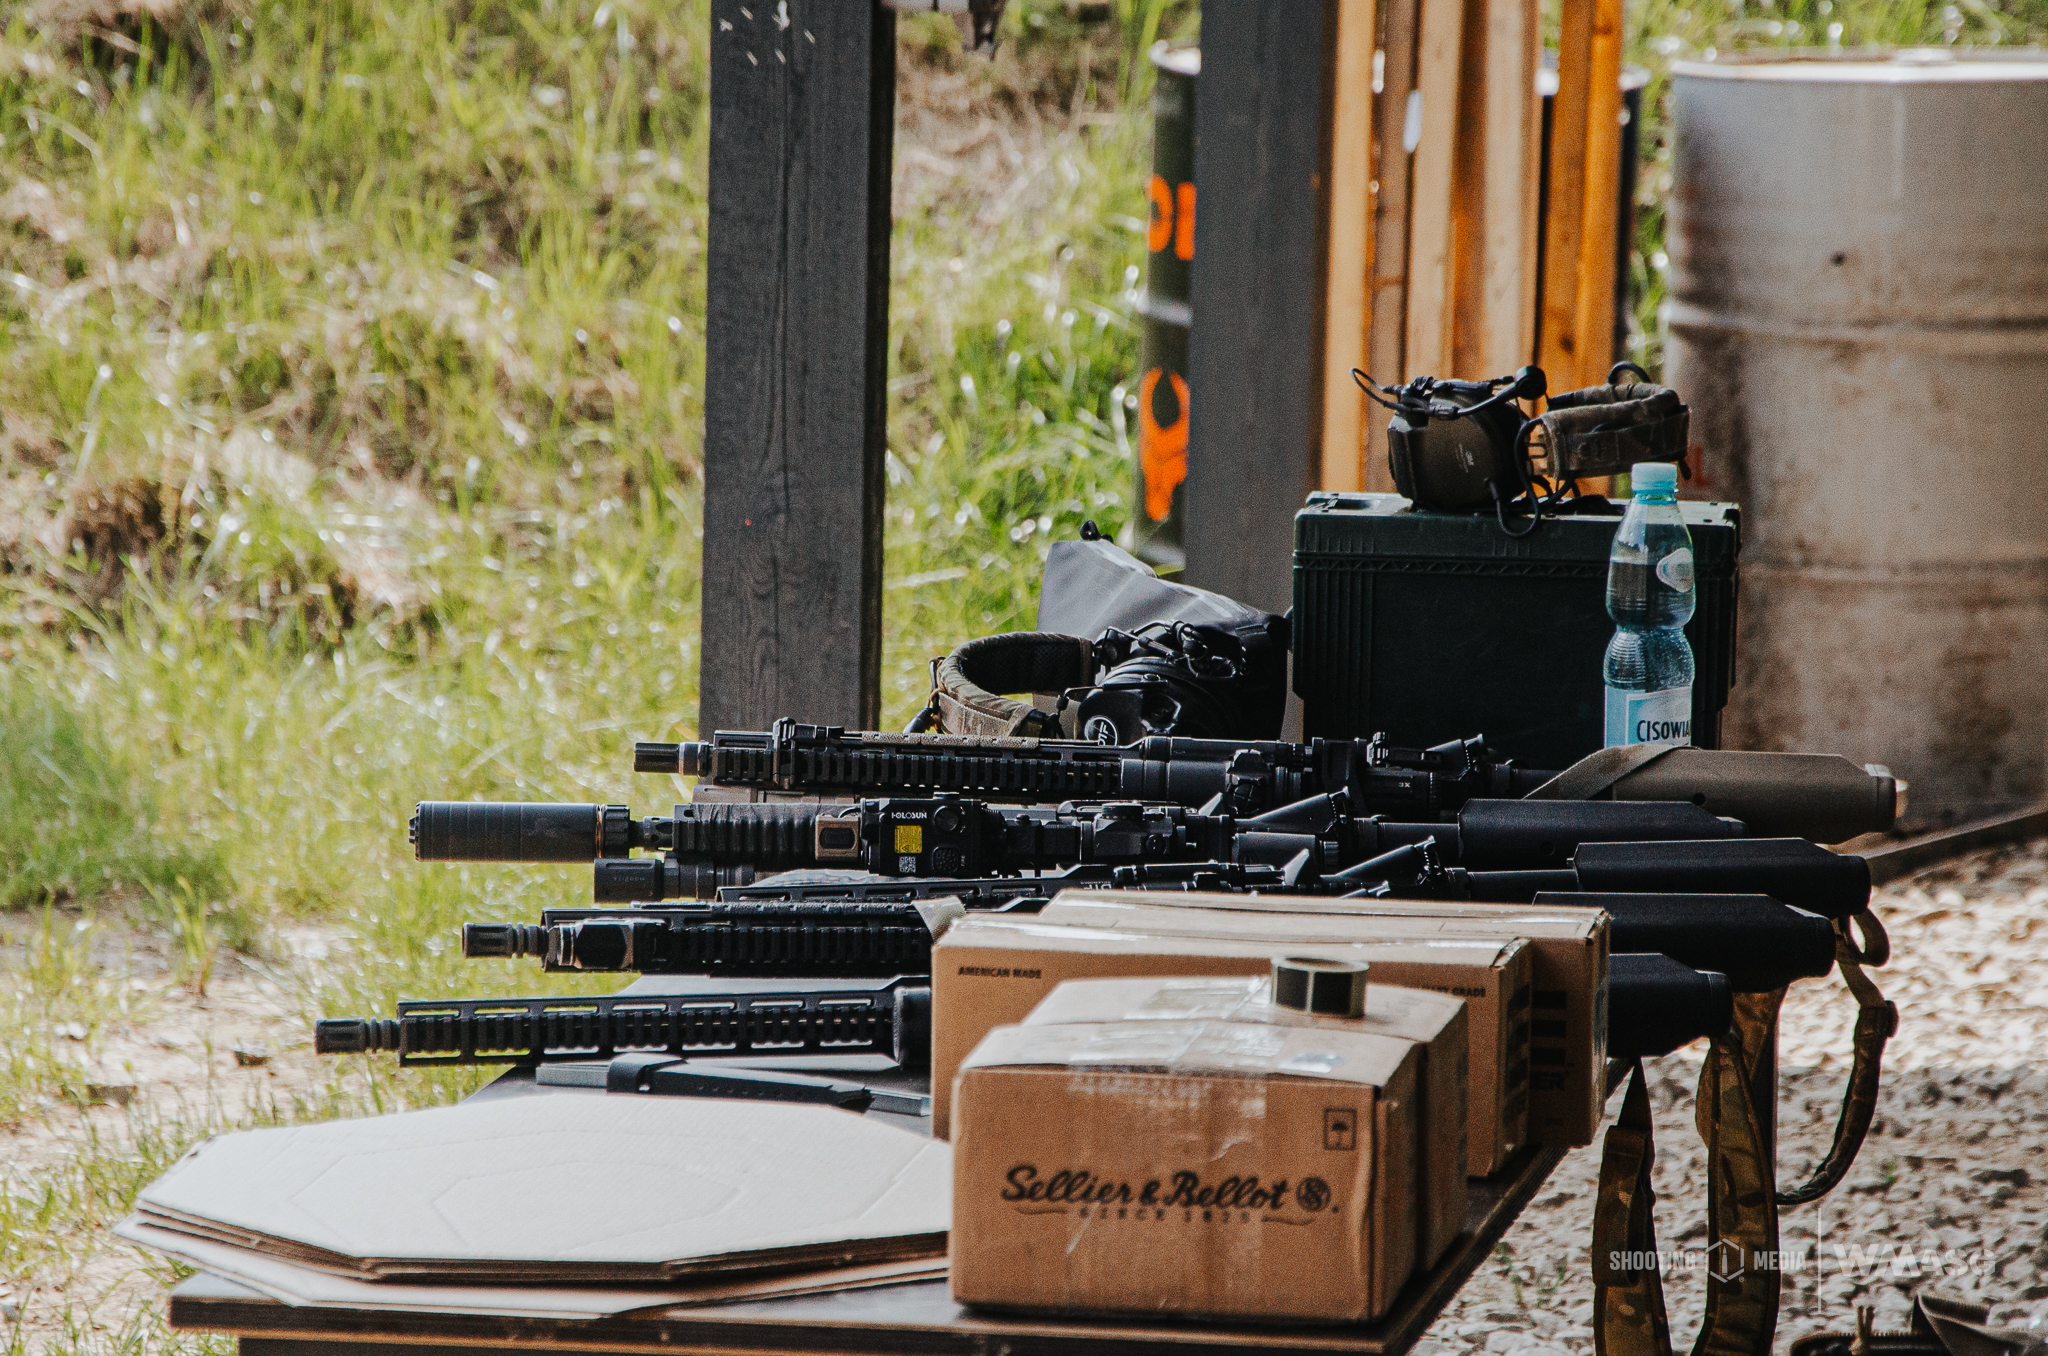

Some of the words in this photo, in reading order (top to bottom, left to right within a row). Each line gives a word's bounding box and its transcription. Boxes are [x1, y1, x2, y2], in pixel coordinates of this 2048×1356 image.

[891, 811, 928, 819] HOLOSUN
[958, 966, 1010, 977] AMERICAN
[1013, 968, 1042, 979] MADE
[1451, 986, 1486, 998] GRADE
[1001, 1164, 1133, 1203] Sellier
[1162, 1169, 1288, 1209] Bellot
